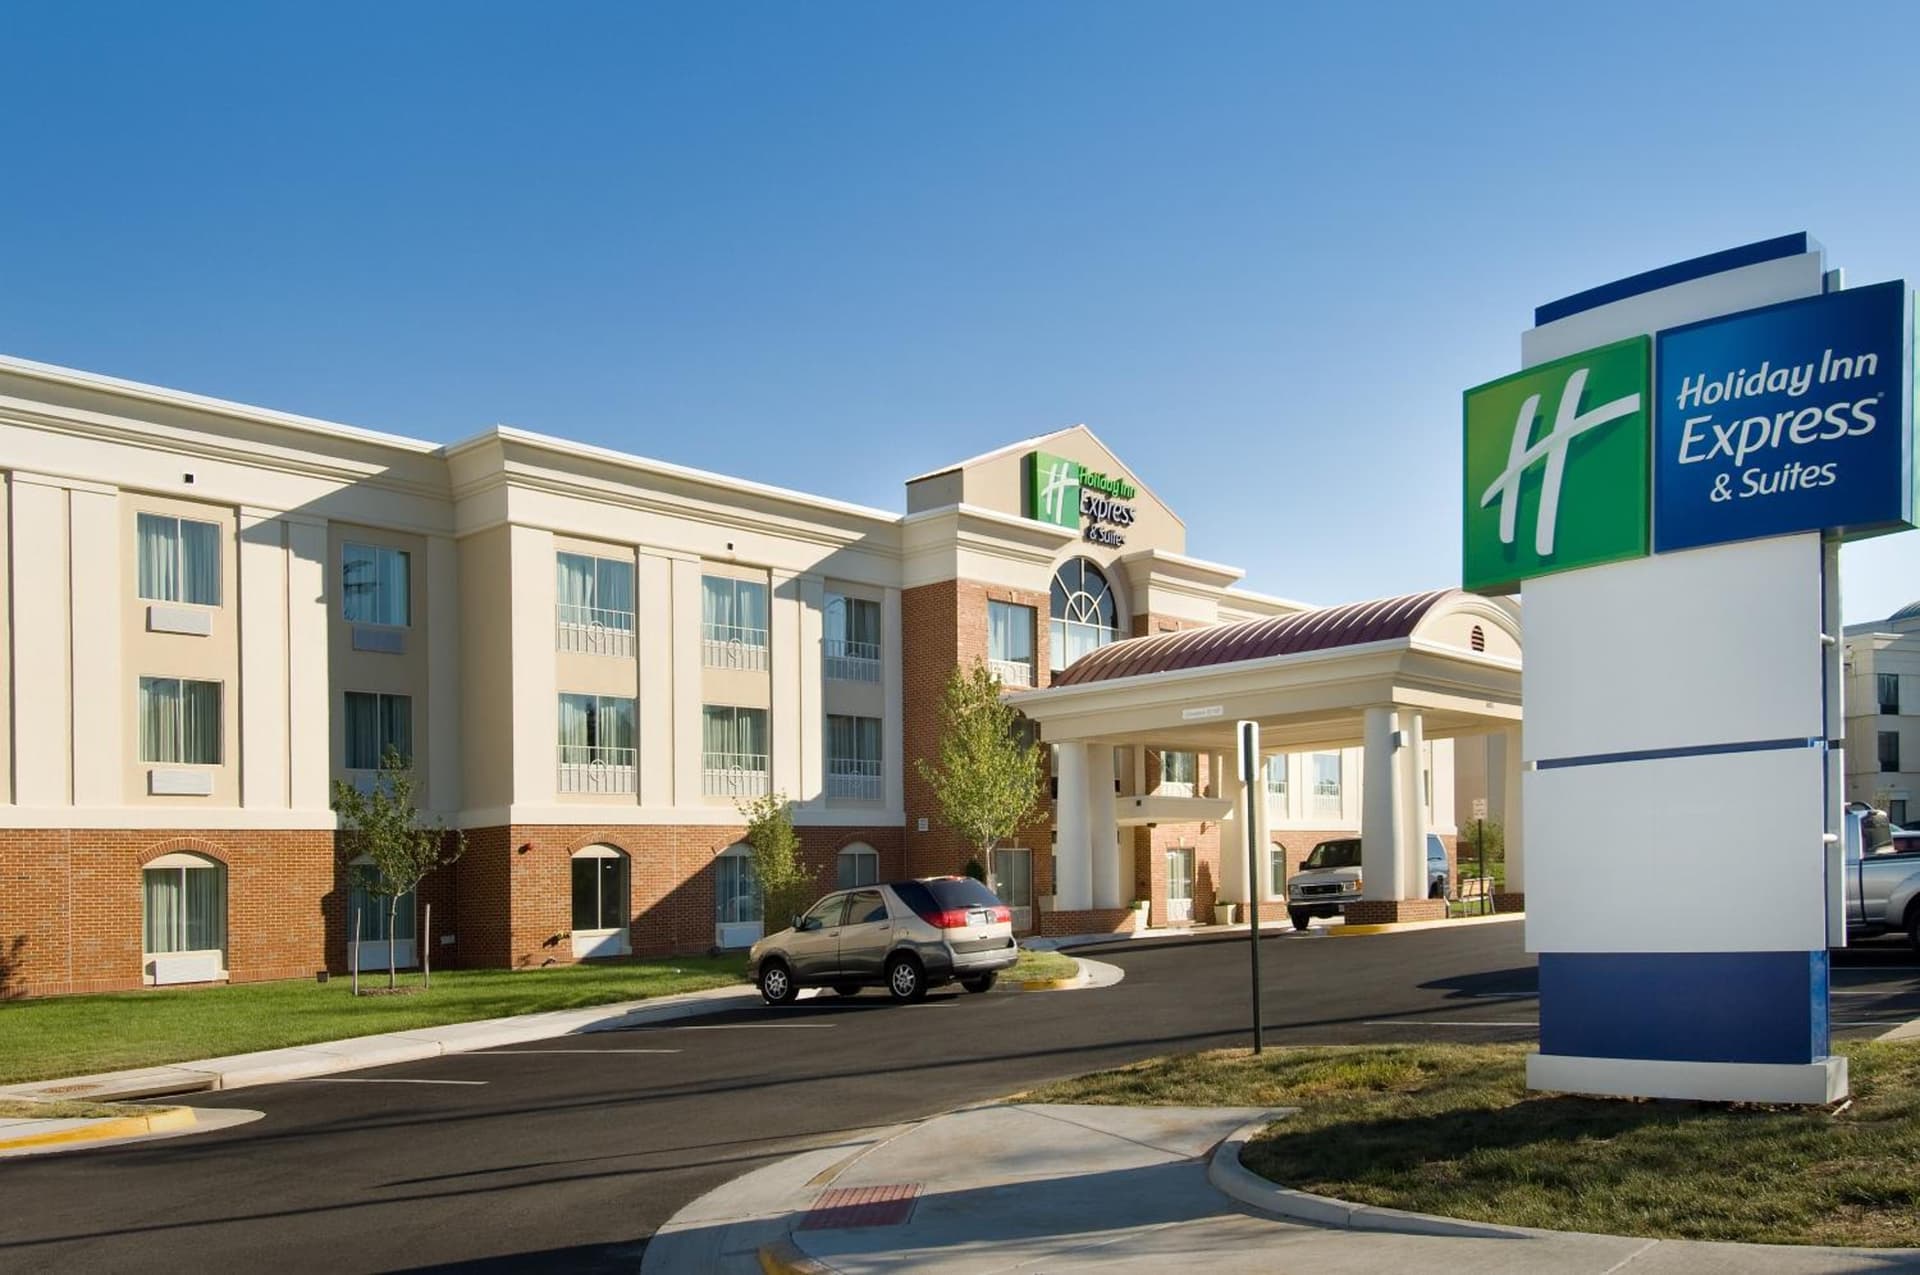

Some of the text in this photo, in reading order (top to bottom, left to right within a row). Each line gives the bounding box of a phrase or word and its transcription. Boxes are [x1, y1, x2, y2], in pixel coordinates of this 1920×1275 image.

[1676, 348, 1878, 410] Holiday Inn
[1677, 397, 1879, 467] Express
[1079, 465, 1136, 499] Holiday Inn
[1709, 461, 1838, 503] & Suites
[1080, 487, 1136, 525] Express
[1089, 524, 1098, 540] &
